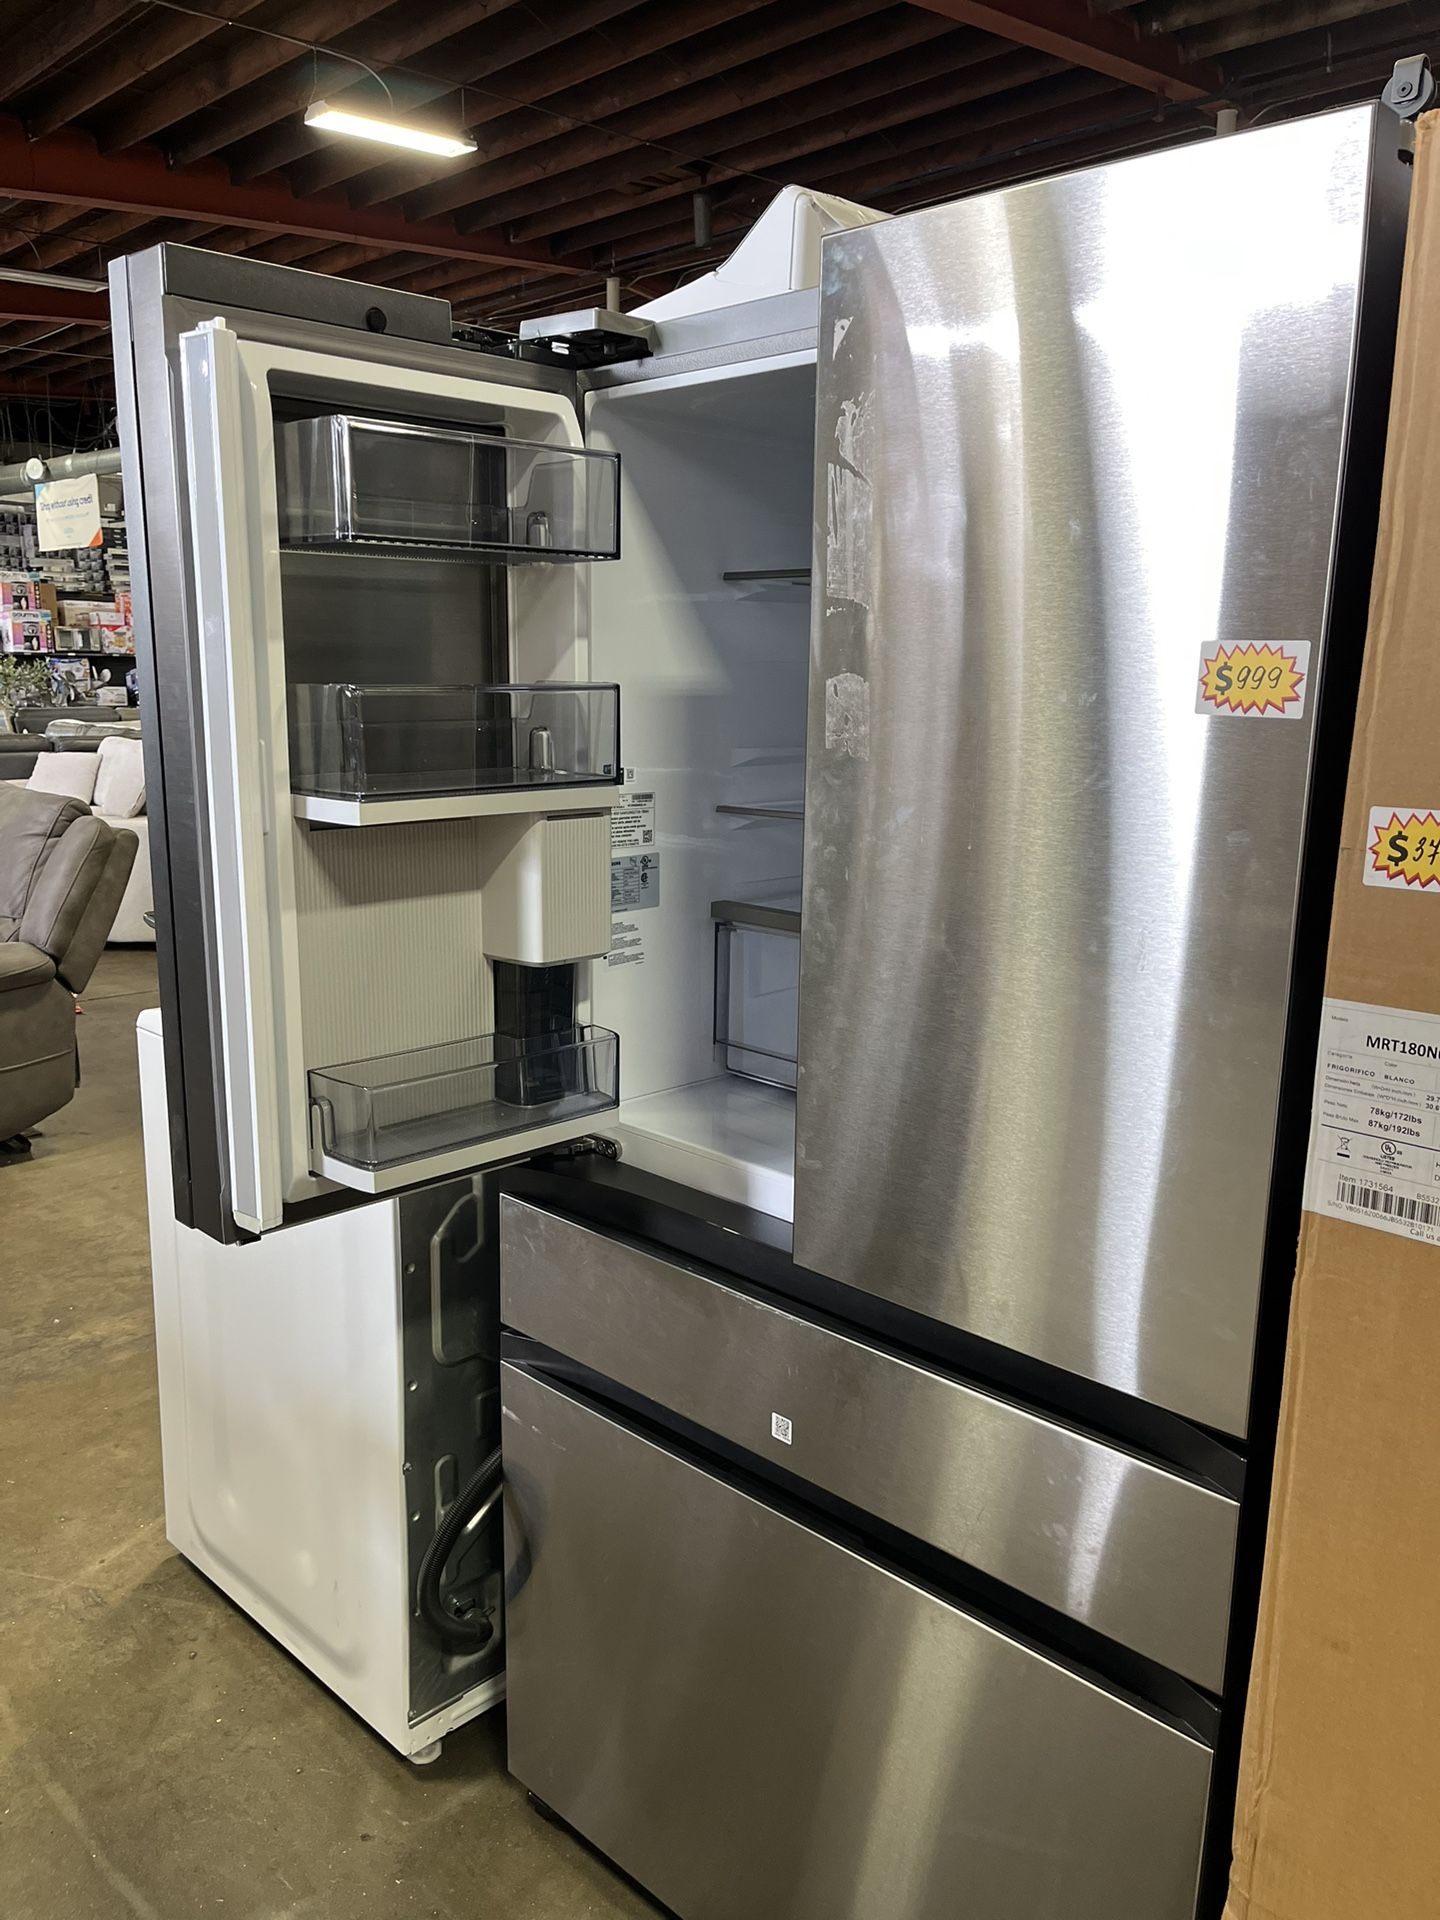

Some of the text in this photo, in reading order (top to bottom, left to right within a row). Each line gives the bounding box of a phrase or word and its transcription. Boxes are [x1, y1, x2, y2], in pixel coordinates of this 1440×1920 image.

[1214, 661, 1283, 695] $999
[1365, 1035, 1440, 1060] MRT180N
[1327, 1063, 1376, 1077] FRIGORIFICO
[1384, 1074, 1415, 1085] BLANCO
[1370, 1106, 1422, 1125] 78kg/172lbs
[1368, 1119, 1421, 1138] 87kg/192lbs
[1339, 1173, 1394, 1193] Item 1731564
[1410, 1228, 1424, 1238] Call
[1426, 1233, 1435, 1241] us
